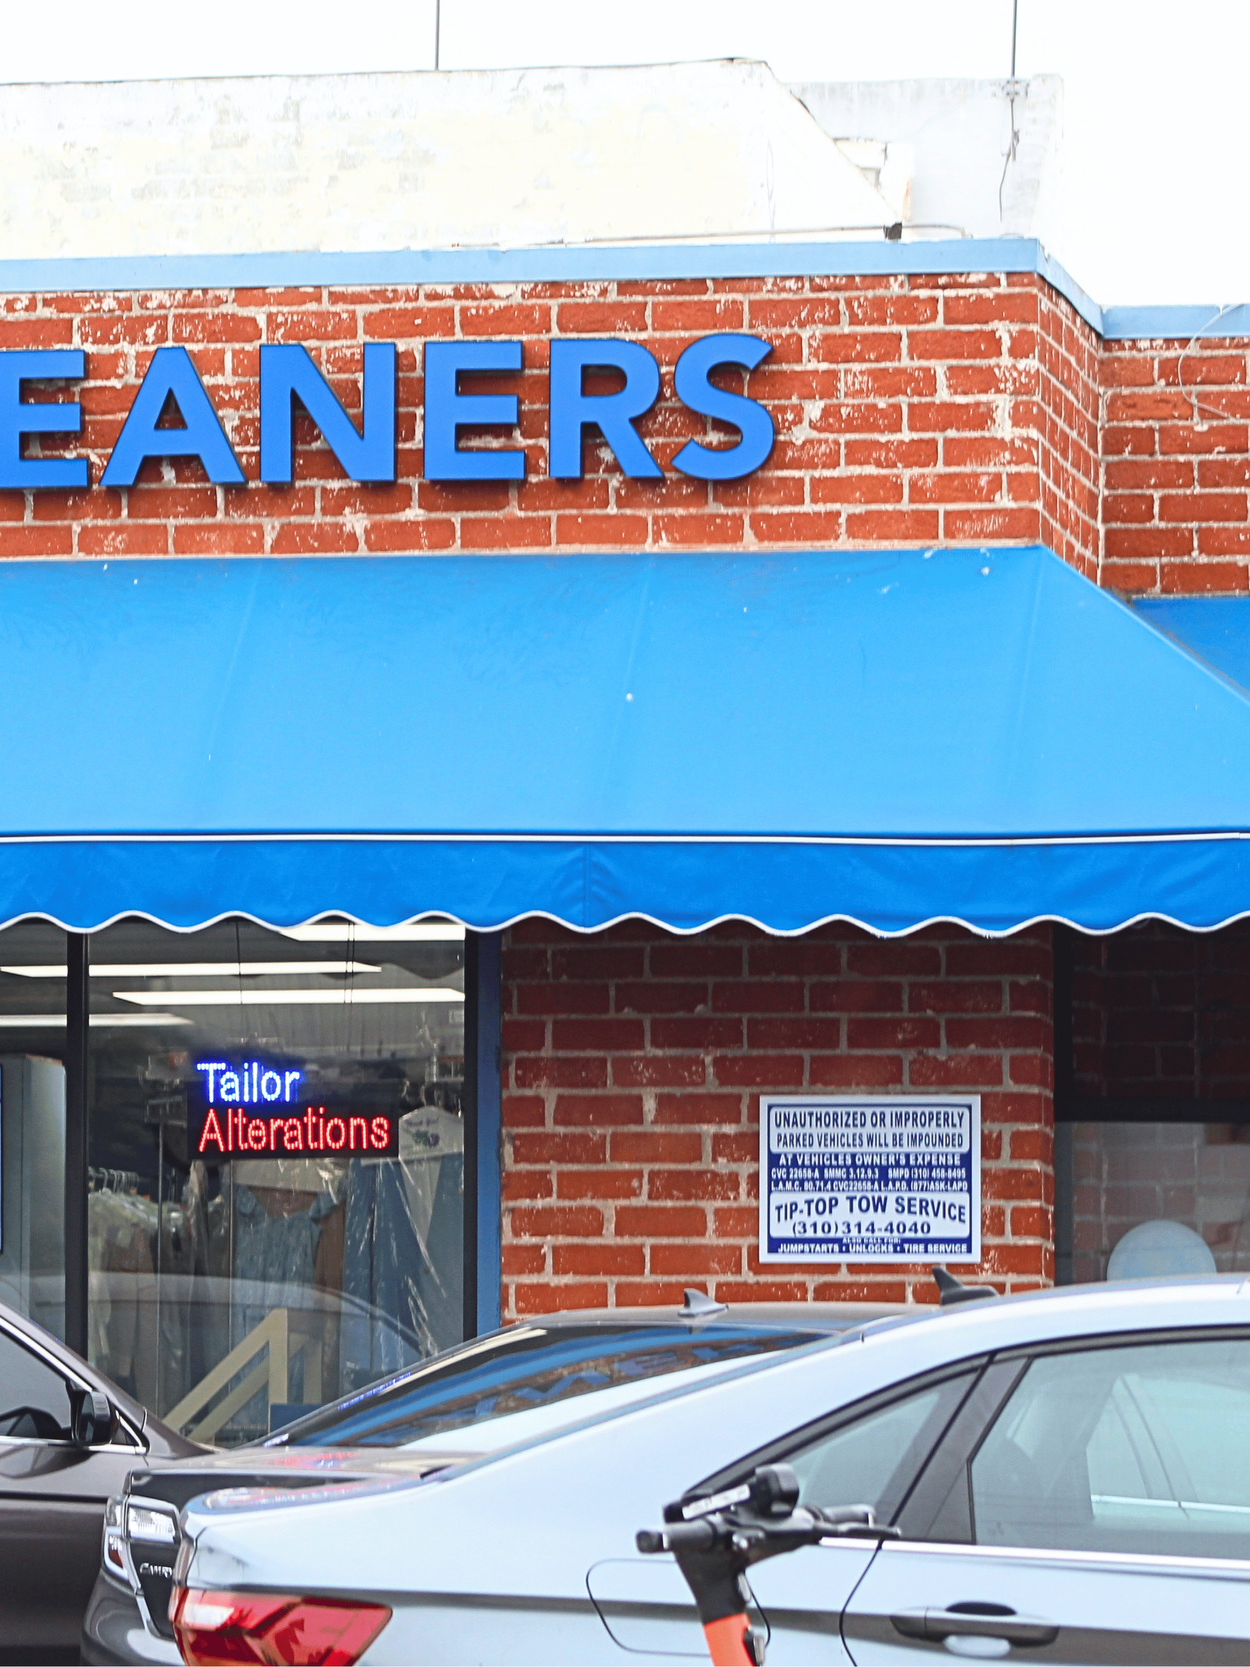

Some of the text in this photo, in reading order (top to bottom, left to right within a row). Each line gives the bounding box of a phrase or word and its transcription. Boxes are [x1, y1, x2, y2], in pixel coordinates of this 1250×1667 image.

[195, 1061, 301, 1103] Tailor
[774, 1111, 964, 1128] UNAUTHORIZED OR IMPROPERLY
[197, 1106, 390, 1153] Alterations
[777, 1132, 964, 1148] PARKED VEHICLES WILL BE IMPOUNDED
[779, 1153, 961, 1166] AT VEHICLES OWNER'S EXPENSE
[771, 1168, 787, 1180] CVC
[789, 1168, 820, 1180] 22658-A
[824, 1168, 847, 1180] SMMC
[888, 1168, 910, 1180] SMPD
[911, 1168, 930, 1180] (310)
[775, 1194, 966, 1224] TIP-TOP TOW SERVICE
[792, 1220, 931, 1237] (310)314-4040
[778, 1243, 968, 1254] JUMPSTARTS UNLOCKS TIRE SERVICE
